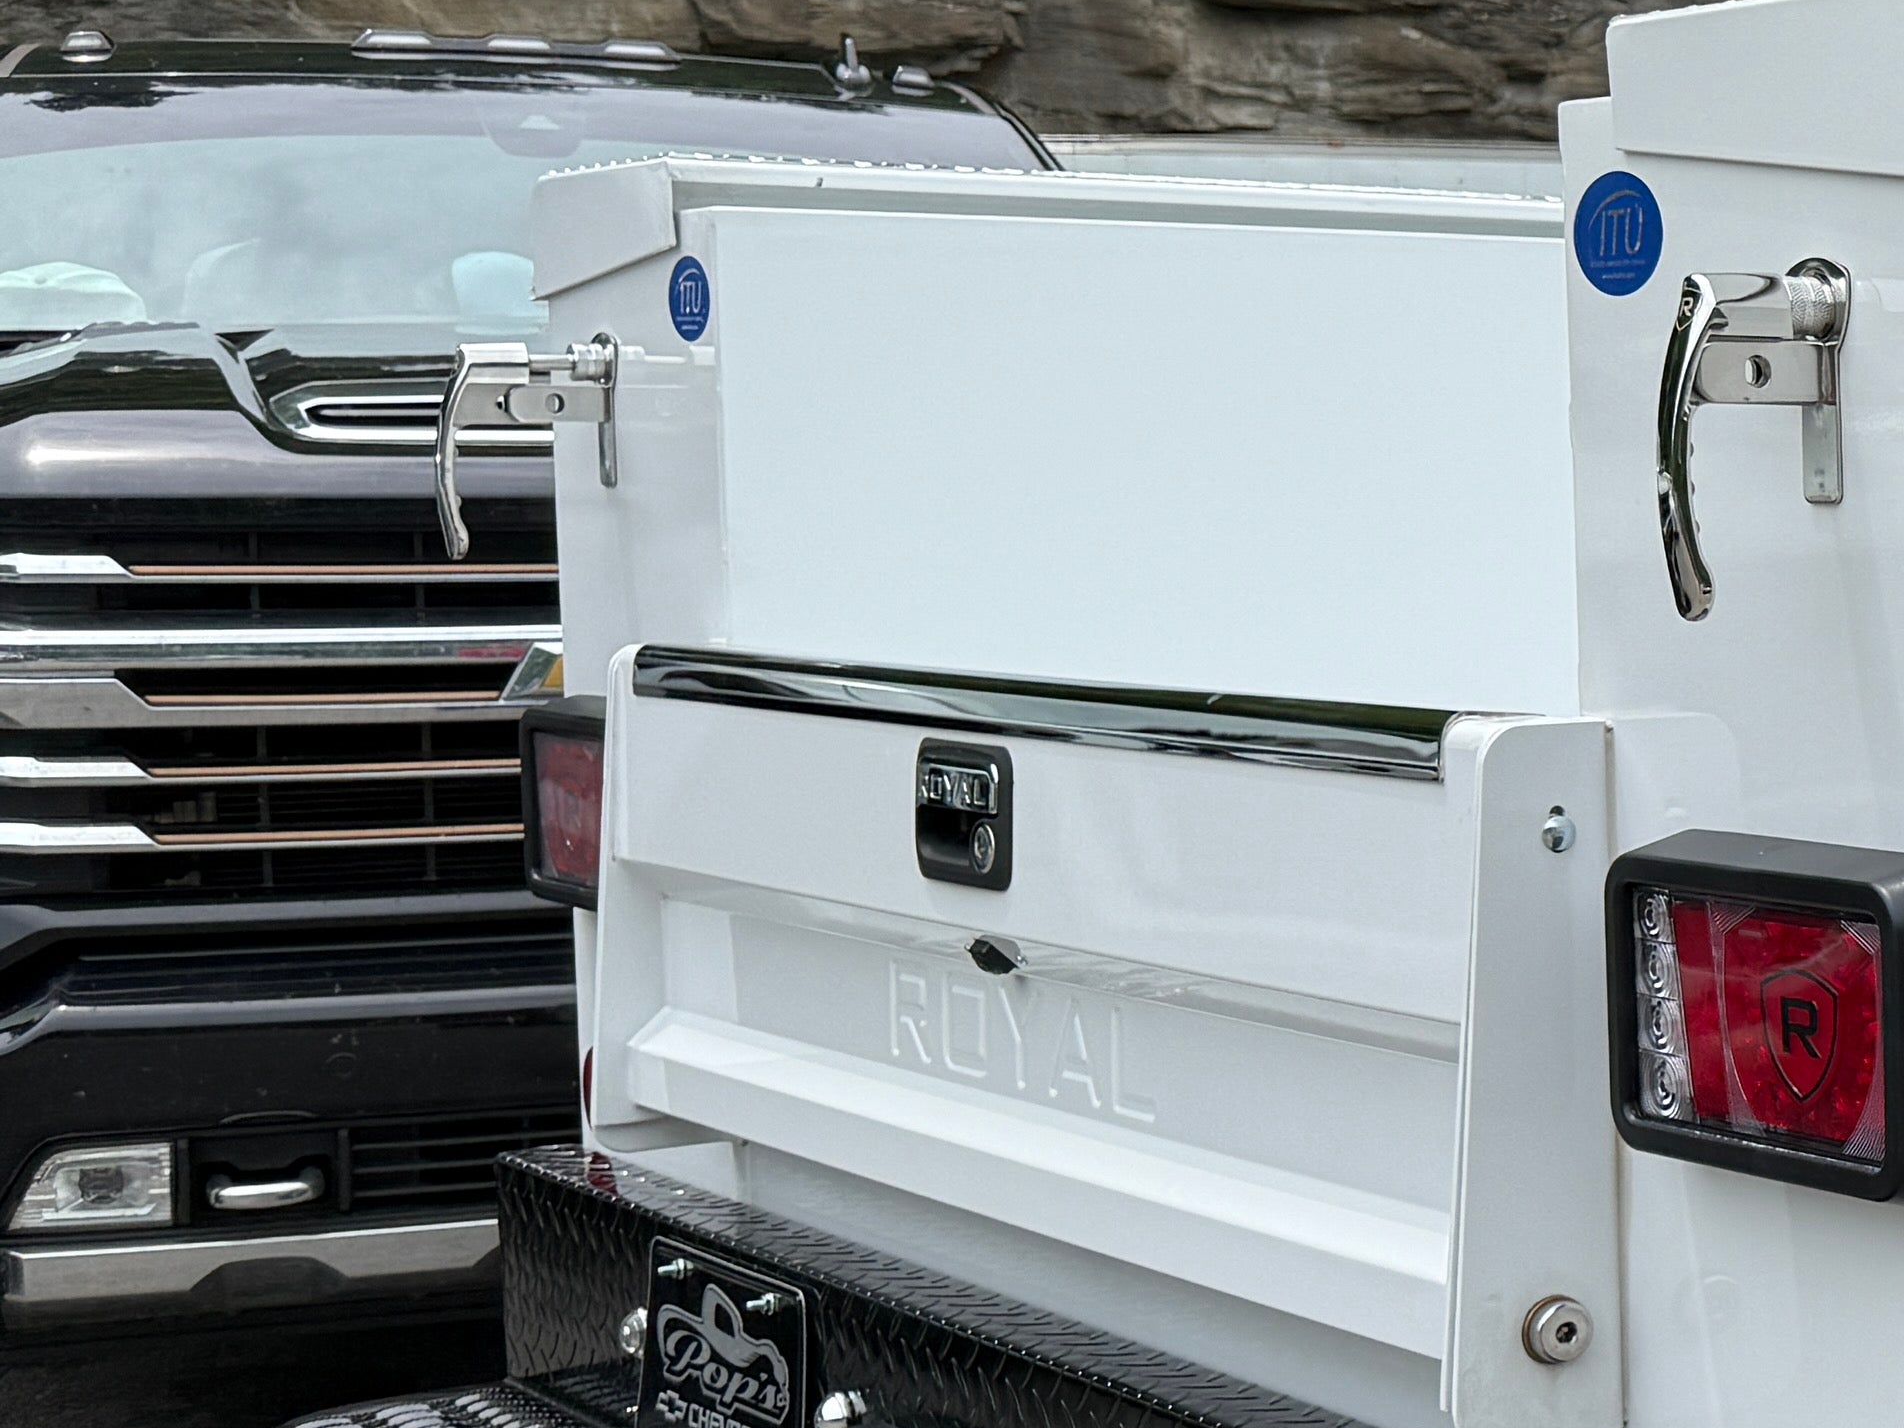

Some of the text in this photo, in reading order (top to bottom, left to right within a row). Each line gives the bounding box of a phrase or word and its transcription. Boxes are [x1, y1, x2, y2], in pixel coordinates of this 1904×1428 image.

[1680, 297, 1693, 317] R
[890, 961, 1156, 1123] ROYAL
[1780, 997, 1821, 1059] R
[665, 1329, 782, 1412] Pop's
